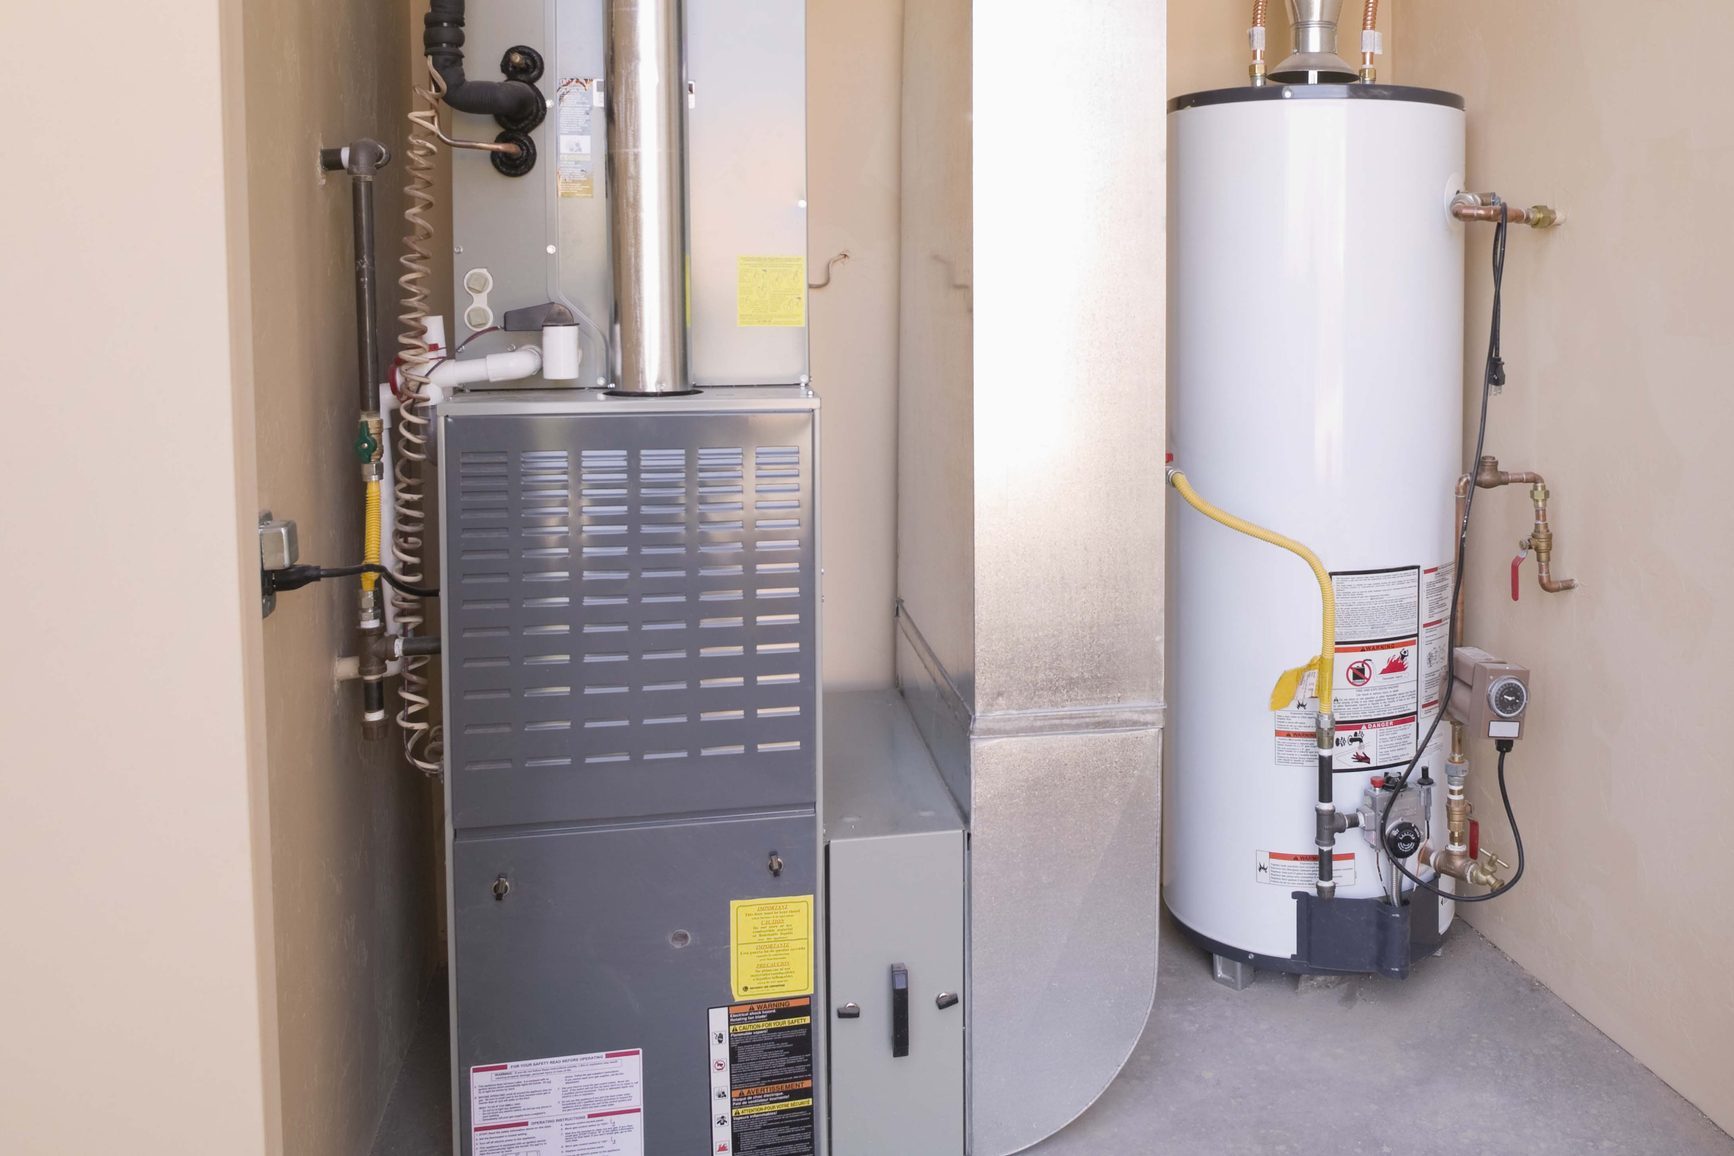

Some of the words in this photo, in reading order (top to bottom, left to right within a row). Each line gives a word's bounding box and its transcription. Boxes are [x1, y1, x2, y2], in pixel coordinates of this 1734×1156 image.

[1365, 643, 1395, 652] WARNING
[1367, 721, 1394, 729] DANGER
[757, 1001, 790, 1010] WARNING
[745, 1082, 805, 1095] AVERTISSEMENT
